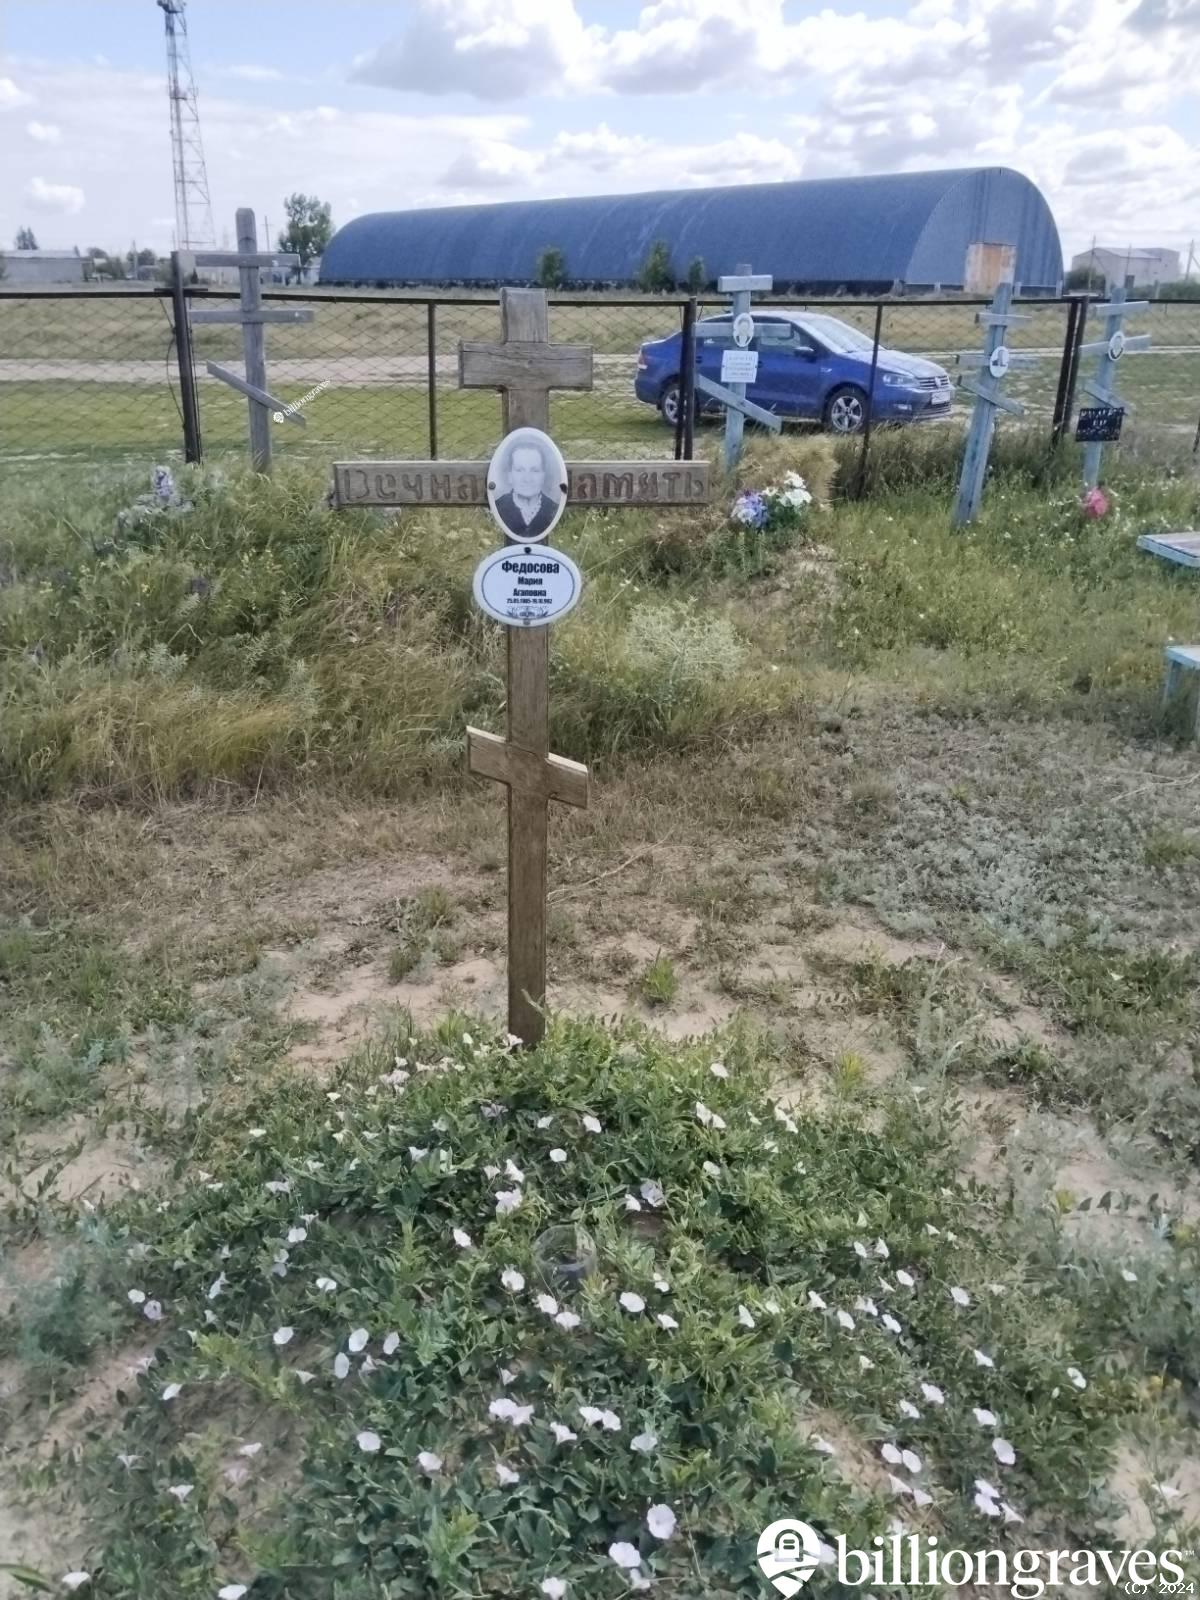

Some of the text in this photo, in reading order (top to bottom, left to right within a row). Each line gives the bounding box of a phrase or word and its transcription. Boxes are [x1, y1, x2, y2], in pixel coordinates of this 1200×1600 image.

[344, 469, 479, 501] Вечна
[501, 560, 560, 575] Федосова
[517, 576, 543, 586] Мария
[513, 588, 547, 597] Агаповна
